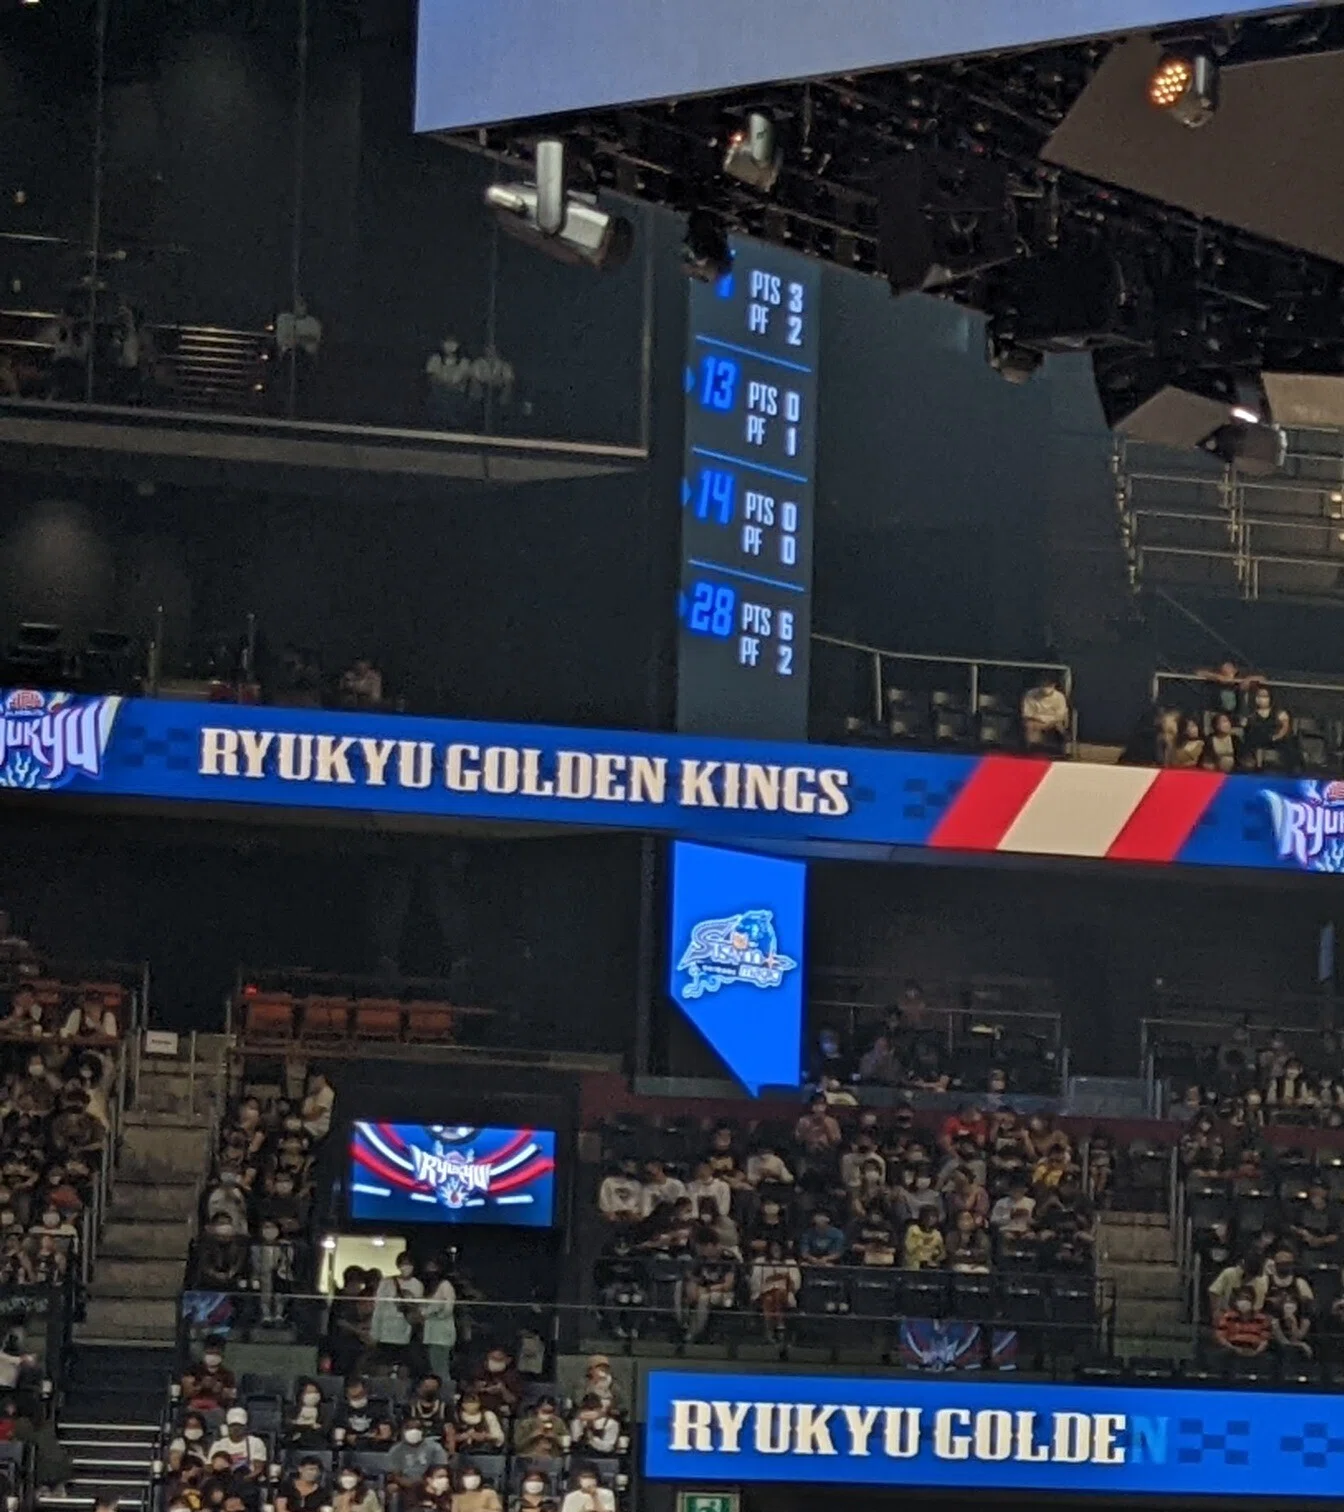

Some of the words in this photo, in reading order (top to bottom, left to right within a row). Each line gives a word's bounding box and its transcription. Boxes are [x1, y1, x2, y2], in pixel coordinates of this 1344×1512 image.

[751, 270, 781, 305] PTS
[789, 283, 804, 313] 3
[750, 303, 769, 334] PF
[787, 316, 802, 345] 2
[702, 355, 738, 410] 13
[749, 381, 778, 416] PTS
[747, 415, 766, 445] PF
[787, 427, 797, 456] 1
[697, 469, 734, 524] 14
[745, 492, 774, 526] PTS
[743, 525, 763, 556] PF
[690, 582, 736, 636] 28
[742, 603, 772, 637] PTS
[780, 611, 794, 641] 6
[739, 636, 760, 667] PF
[777, 645, 793, 675] 2
[0, 698, 99, 779] UKYU
[199, 727, 435, 789] RYUKYU
[446, 744, 668, 804] GOLDEN
[680, 758, 850, 816] KINGS
[668, 1399, 922, 1459] RYUKYU
